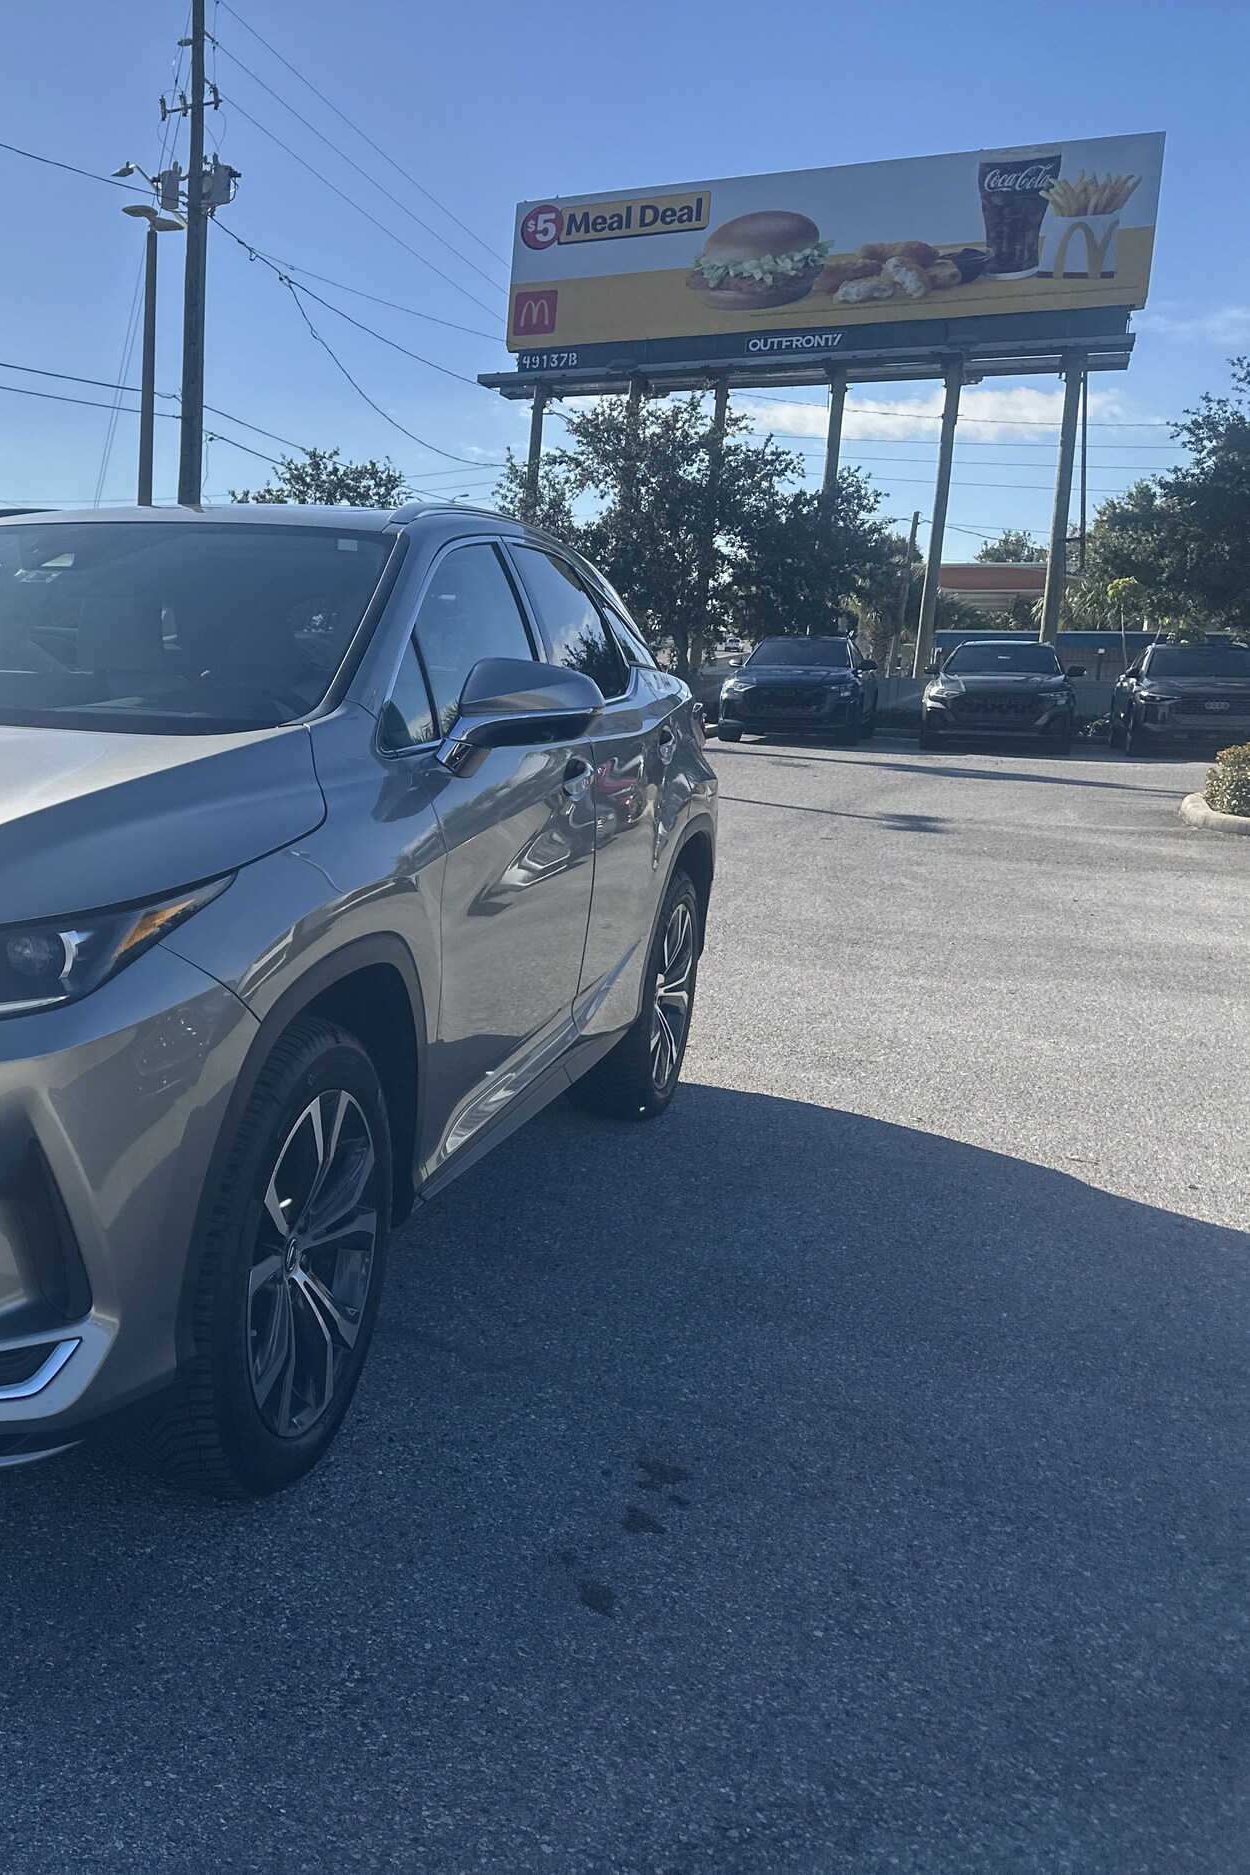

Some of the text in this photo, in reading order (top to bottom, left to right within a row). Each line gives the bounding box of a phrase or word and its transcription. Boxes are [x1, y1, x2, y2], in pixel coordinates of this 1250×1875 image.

[527, 197, 703, 242] $5 Meal Deal
[522, 352, 578, 369] 49137B
